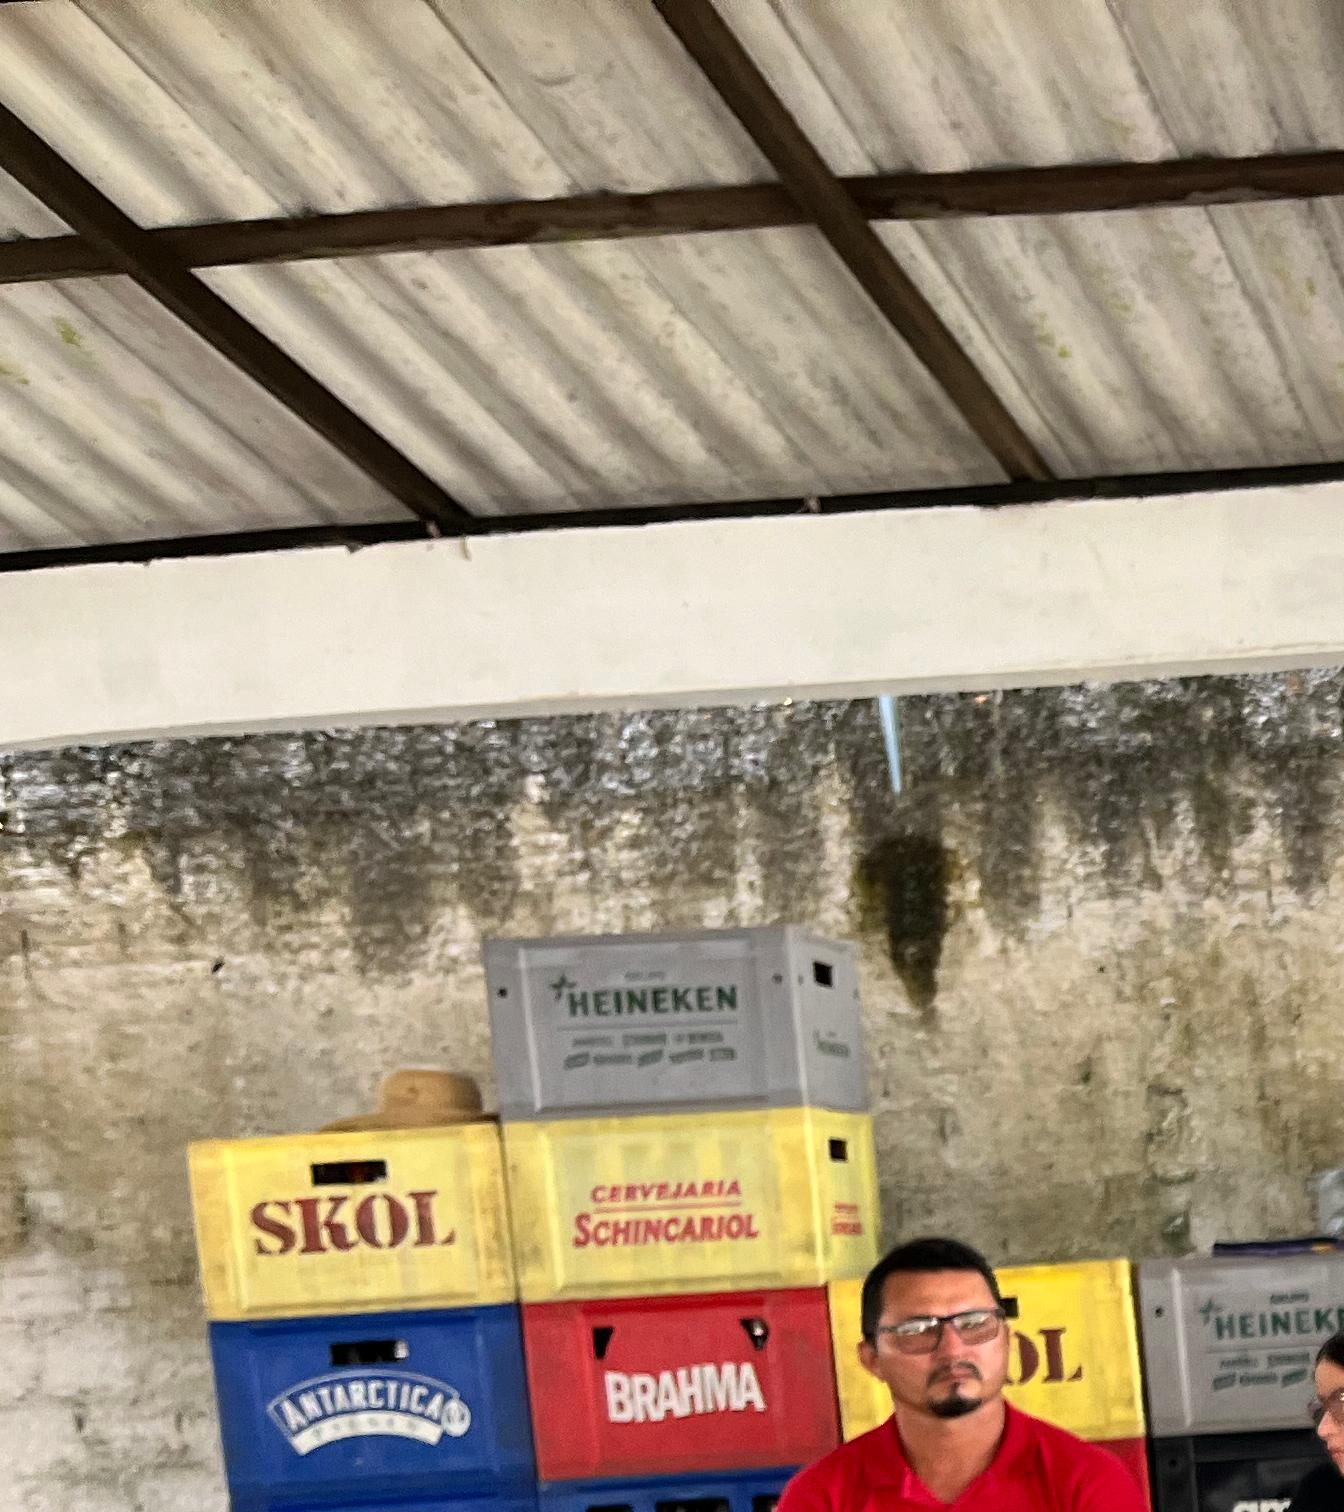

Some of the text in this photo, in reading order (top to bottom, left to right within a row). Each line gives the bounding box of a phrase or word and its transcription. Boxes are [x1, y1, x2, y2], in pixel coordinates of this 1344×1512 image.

[569, 985, 738, 1018] HEINEKEN
[591, 1179, 741, 1204] CERVEJARIA
[250, 1190, 456, 1256] SKOL
[573, 1212, 761, 1249] SCHINCARIOL
[1003, 1326, 1084, 1386] OL
[280, 1379, 445, 1433] ANTARCTICA
[604, 1362, 766, 1424] BRAHMA
